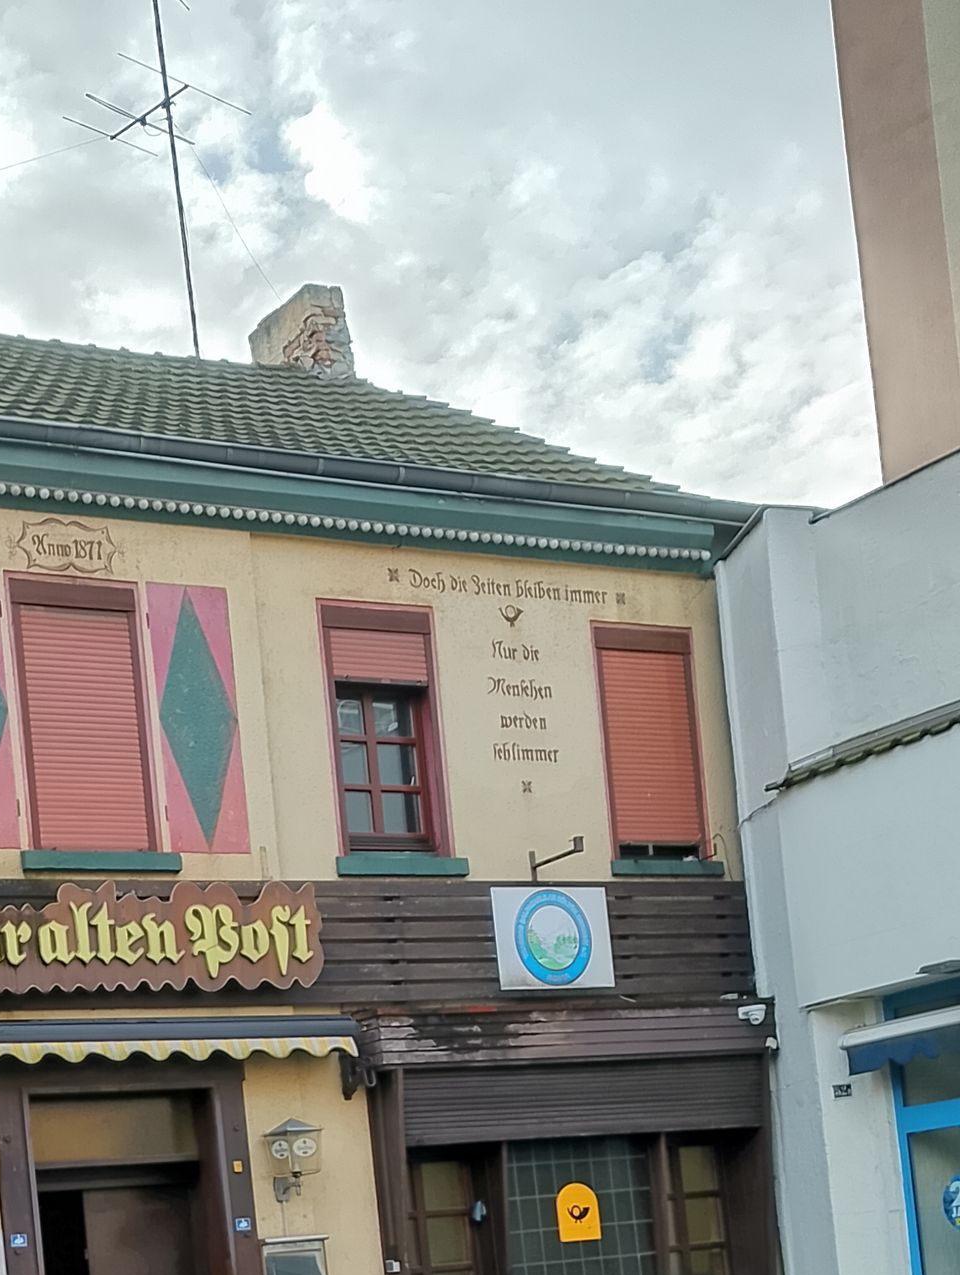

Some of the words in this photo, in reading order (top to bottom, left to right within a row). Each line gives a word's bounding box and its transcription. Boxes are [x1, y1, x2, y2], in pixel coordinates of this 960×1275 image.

[32, 533, 71, 557] Anno
[72, 539, 103, 561] 1871
[408, 568, 446, 594] Doch
[450, 574, 468, 593] die
[471, 574, 511, 597] Zeiten
[516, 579, 561, 601] bleiben
[565, 585, 608, 605] immer
[492, 639, 518, 660] Nur
[521, 643, 540, 661] die
[487, 676, 553, 701] Menschen
[500, 711, 547, 730] werden
[493, 742, 560, 763] schlimmer
[39, 901, 186, 966] alten
[184, 904, 315, 979] Post
